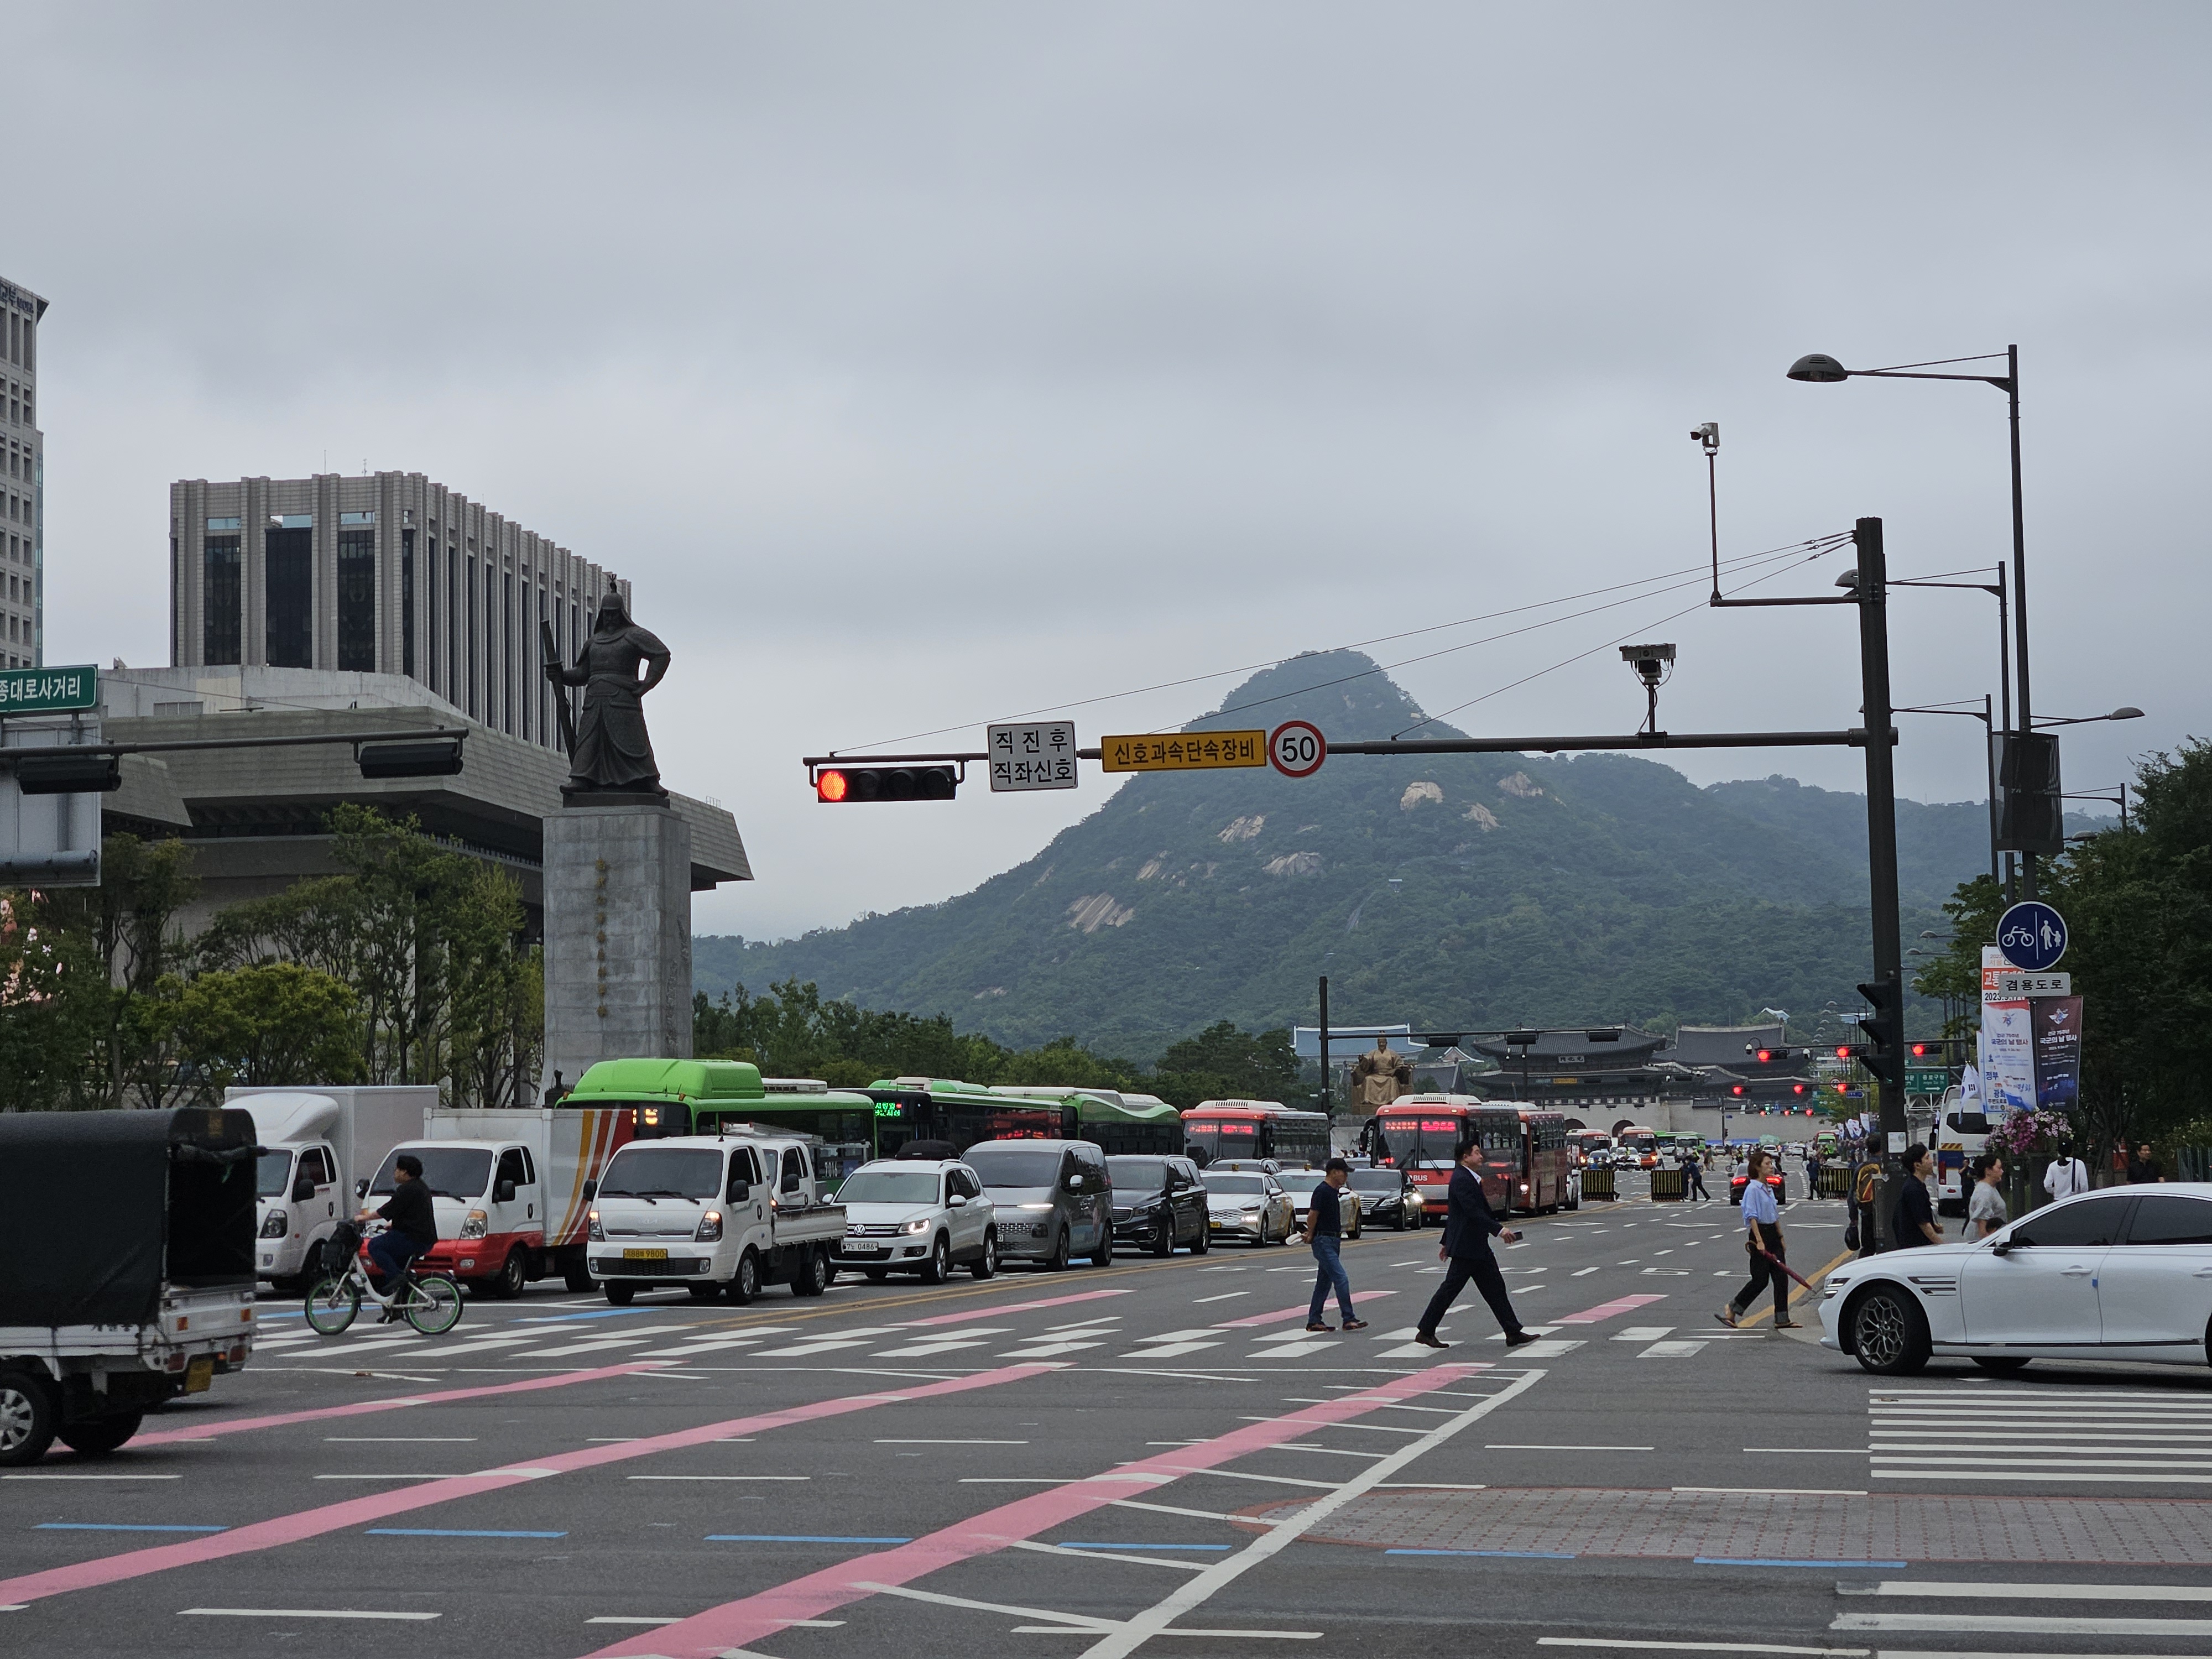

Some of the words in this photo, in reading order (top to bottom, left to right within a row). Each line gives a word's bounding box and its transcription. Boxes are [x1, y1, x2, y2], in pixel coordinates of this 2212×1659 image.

[1114, 737, 1255, 766] 신호과속단속장비
[1281, 736, 1316, 763] 50
[994, 758, 1073, 785] 직좌신호
[2006, 979, 2064, 992] 겸용도로
[824, 1161, 838, 1177] 7016
[645, 1250, 664, 1258] 9800
